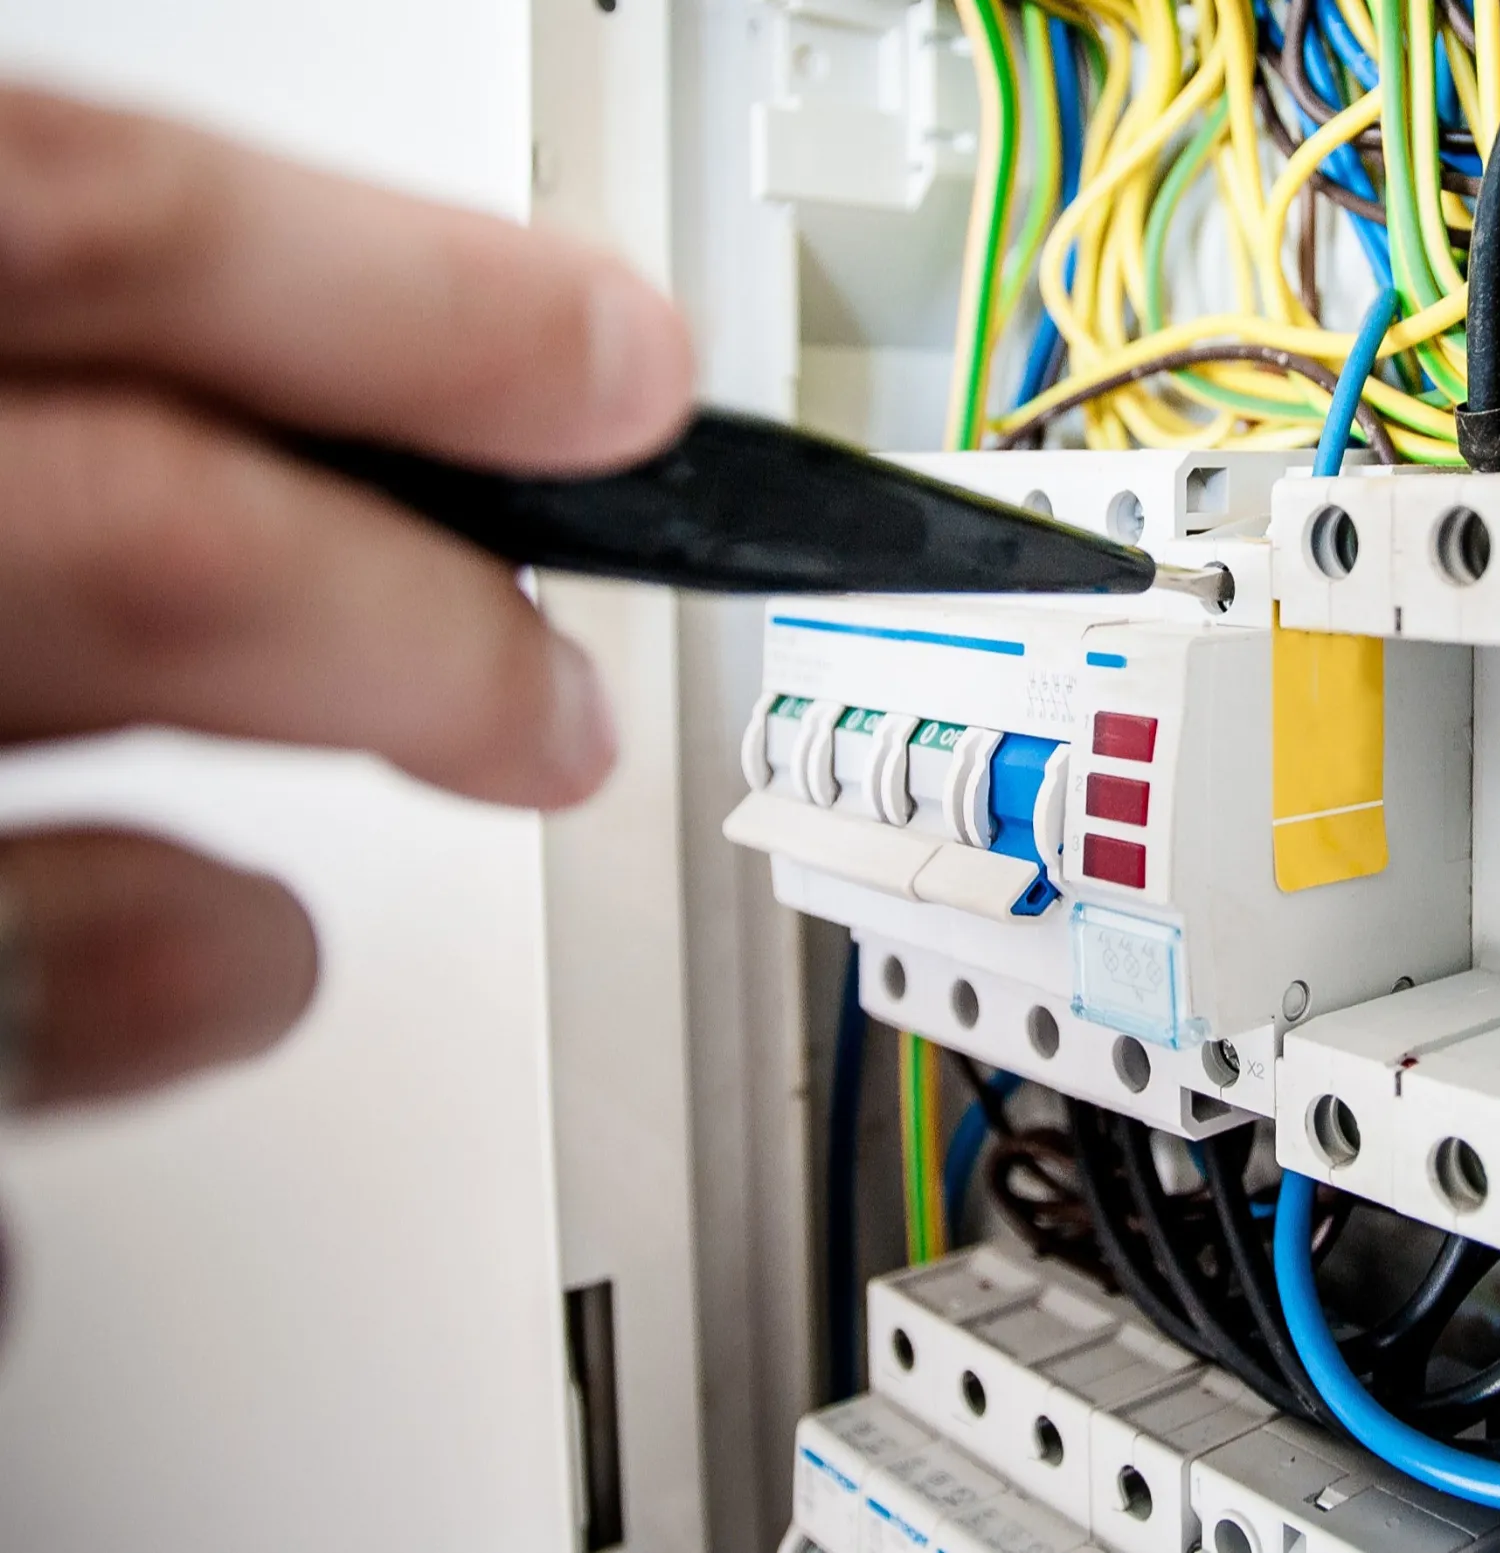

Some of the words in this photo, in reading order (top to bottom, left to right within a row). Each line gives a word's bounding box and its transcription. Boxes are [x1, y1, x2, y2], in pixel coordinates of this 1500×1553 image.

[919, 722, 939, 745] 0
[1075, 775, 1083, 792] 2
[1072, 835, 1080, 852] 3
[1246, 1059, 1265, 1080] X2
